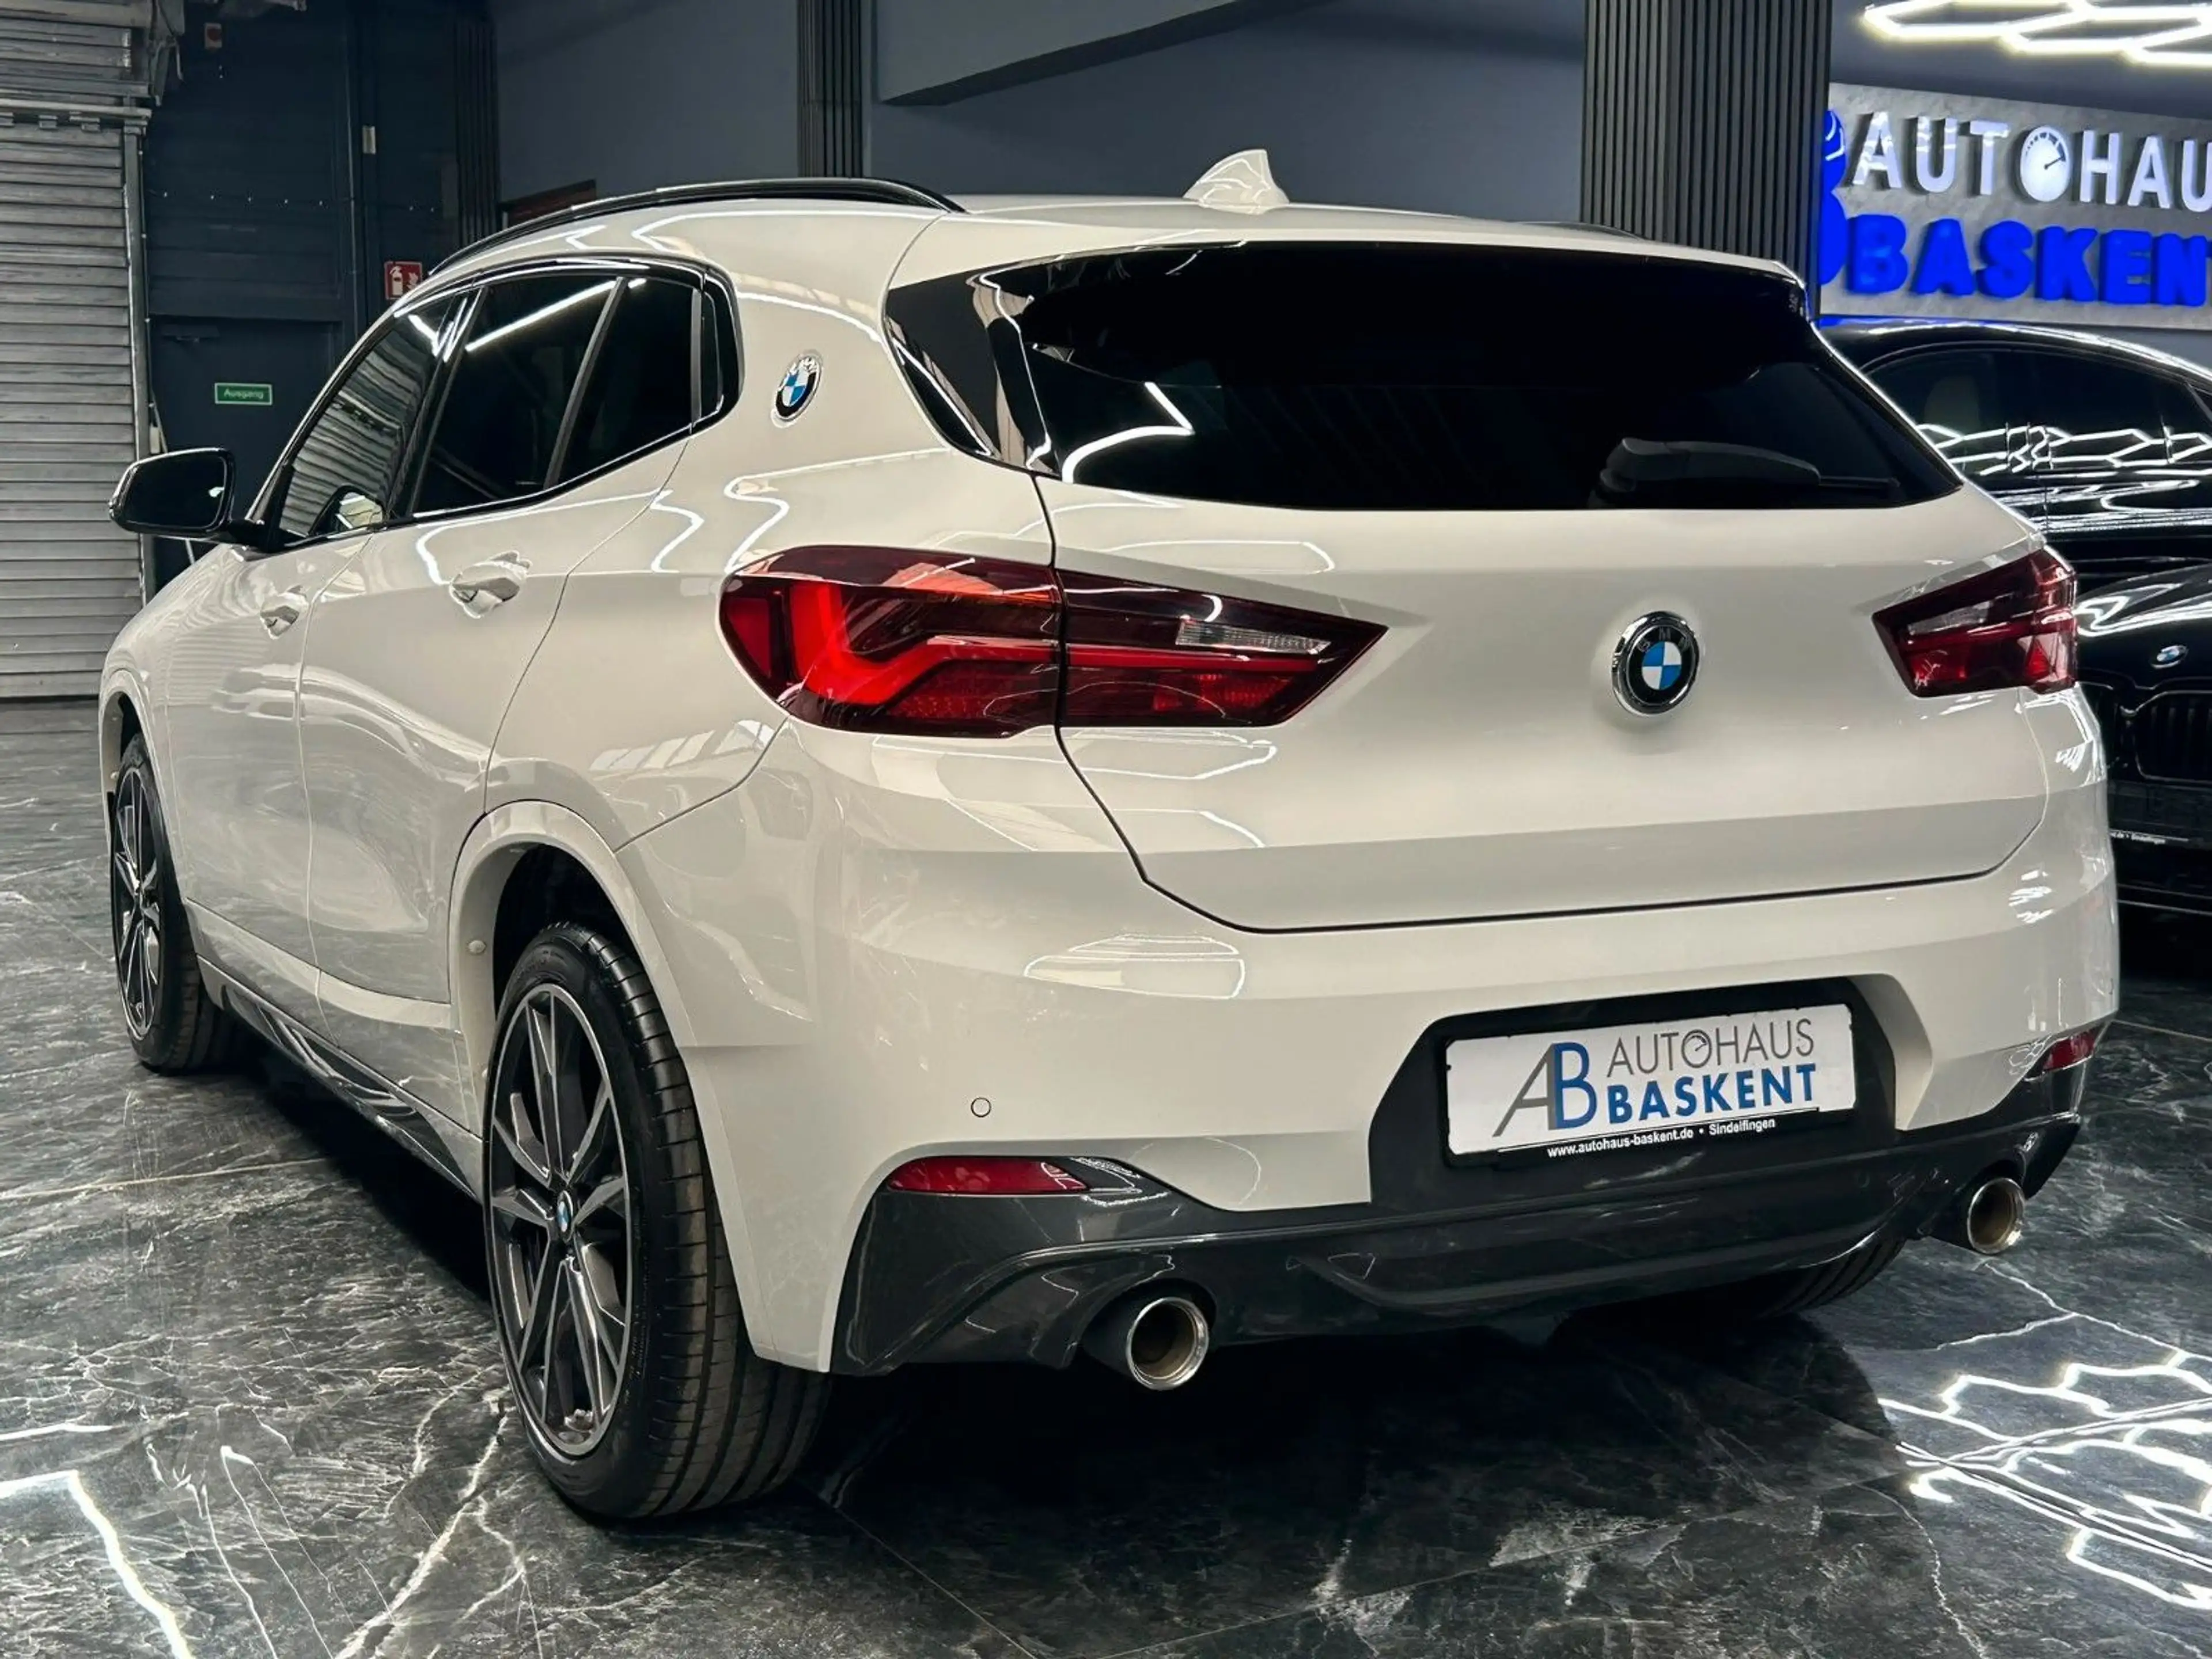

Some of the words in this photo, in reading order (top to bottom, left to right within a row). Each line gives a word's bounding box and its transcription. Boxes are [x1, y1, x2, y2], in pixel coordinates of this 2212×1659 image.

[1845, 214, 2212, 306] BASKEN
[1607, 1018, 1815, 1078] AUTOHAUS
[1492, 1042, 1597, 1137] AB
[1607, 1063, 1816, 1124] BASKENT
[1547, 1128, 1694, 1158] www.autohaus-baskent.de
[1709, 1118, 1775, 1137] Sindelfingen
